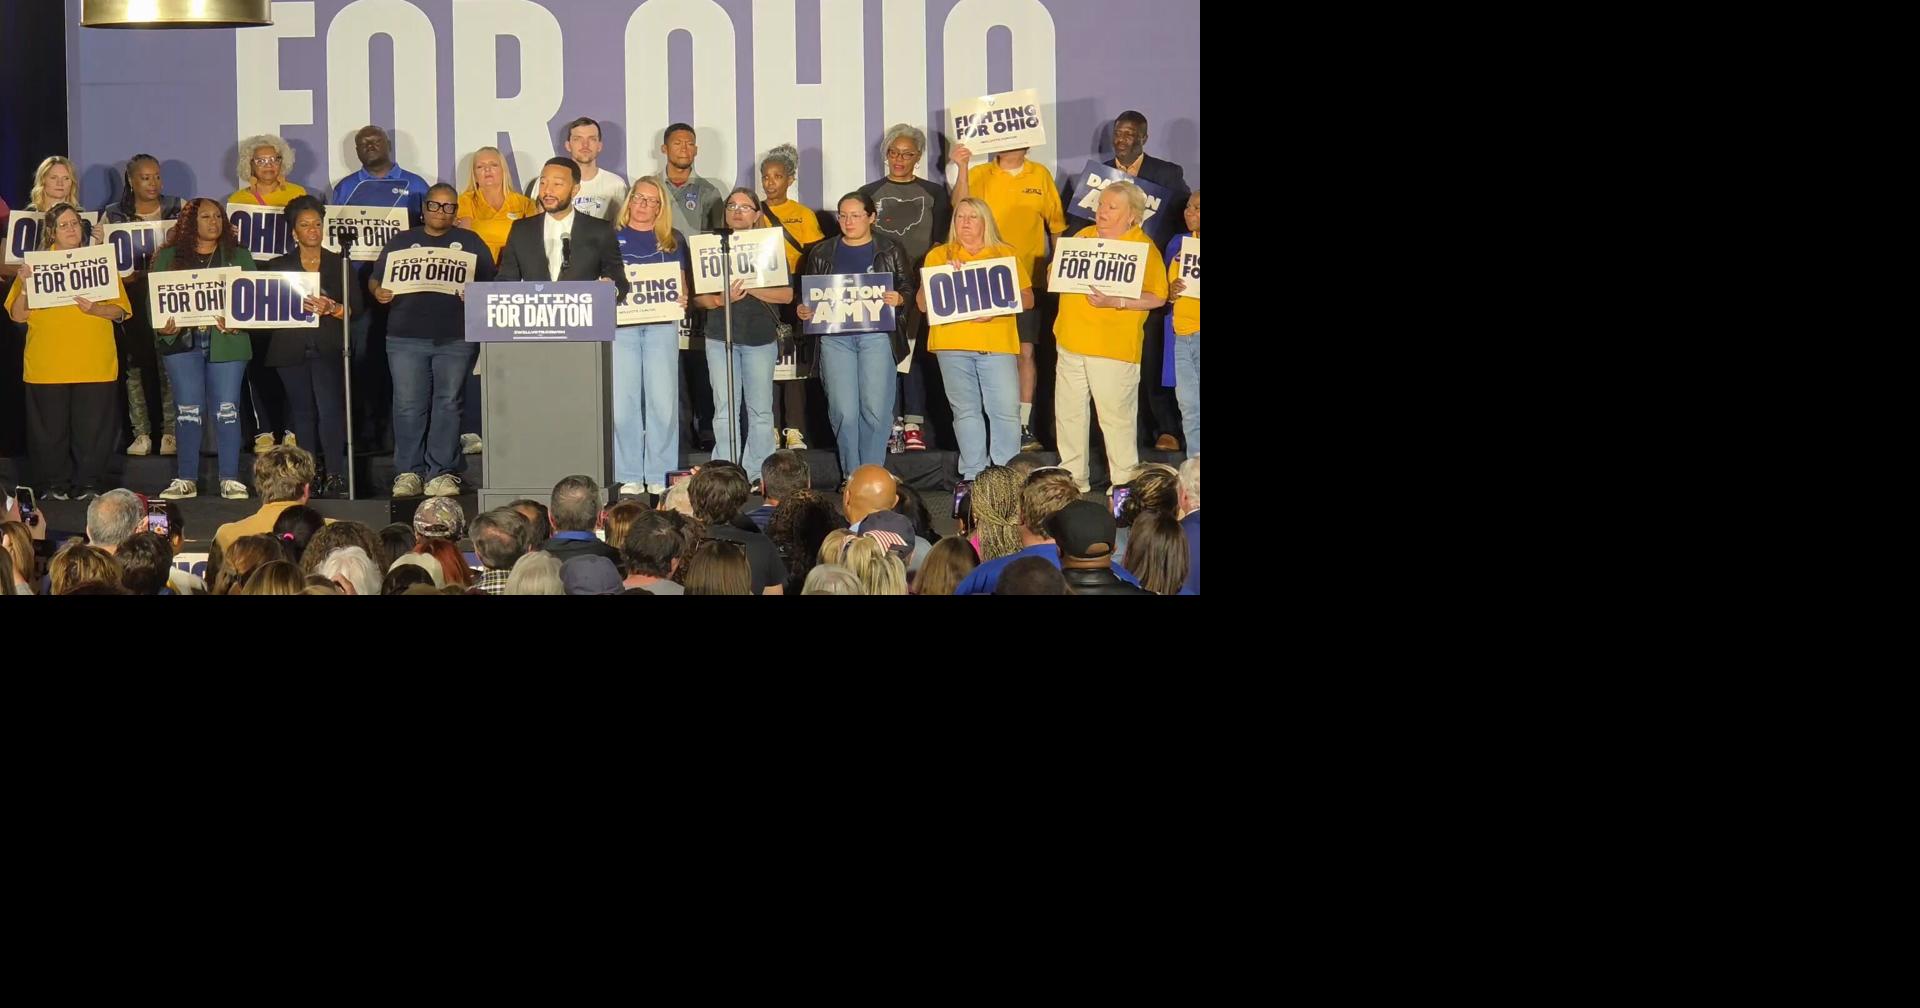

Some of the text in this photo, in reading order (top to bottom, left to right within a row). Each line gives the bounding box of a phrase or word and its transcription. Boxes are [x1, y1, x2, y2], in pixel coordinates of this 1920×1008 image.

[236, 0, 1057, 200] FOR OHIO
[956, 124, 990, 140] FOR
[993, 116, 1040, 134] OHIO
[230, 210, 293, 254] OHI
[328, 218, 401, 227] FIGHTING
[33, 256, 108, 273] FIGHTING
[392, 256, 468, 268] FIGHTING
[1061, 250, 1138, 262] FIGHTING
[1183, 253, 1200, 266] FI
[34, 264, 110, 294] FOR OHIO
[390, 263, 468, 284] FOR OHIO
[1058, 257, 1137, 284] FOR OHIO
[157, 280, 226, 292] FIGHTIN
[809, 285, 886, 301] DAYTON
[929, 264, 1015, 317] OHIO
[158, 289, 226, 314] FOR OHI
[487, 293, 593, 304] FIGHTING
[633, 290, 679, 305] OHIO
[487, 303, 593, 328] FOR DAYTON
[811, 299, 885, 324] AMY
